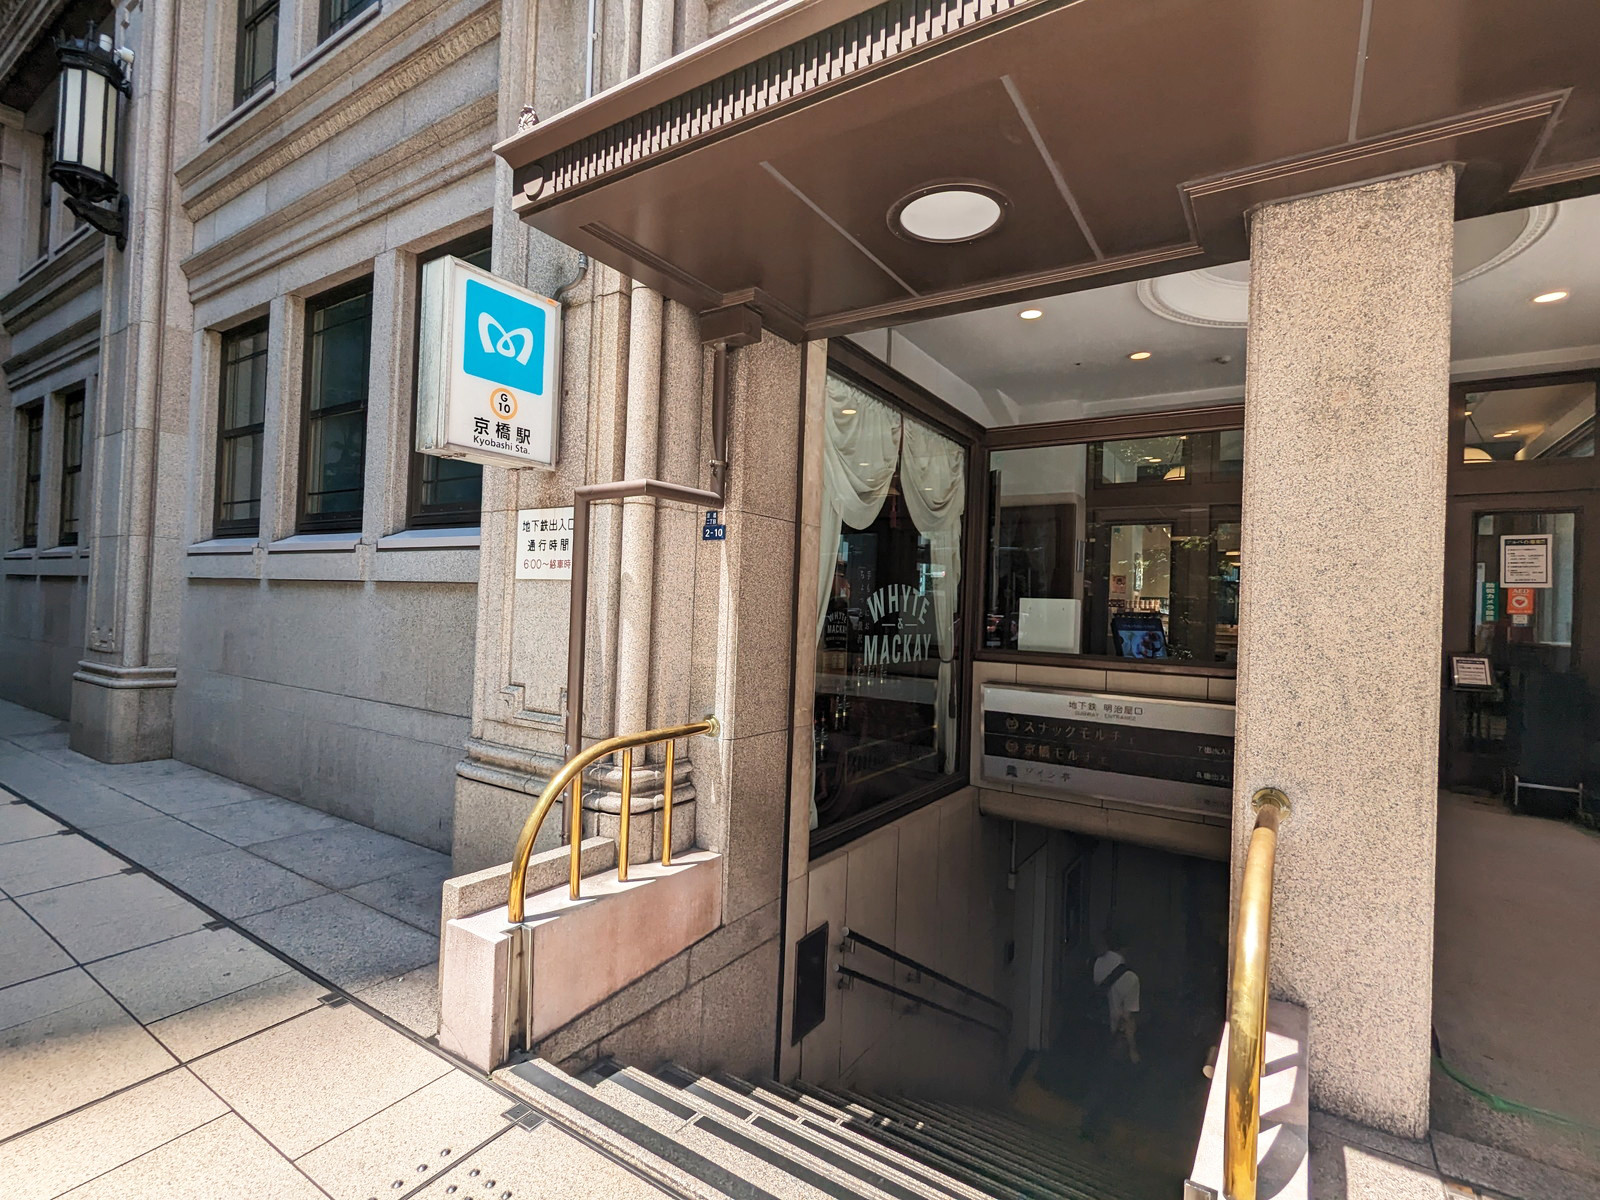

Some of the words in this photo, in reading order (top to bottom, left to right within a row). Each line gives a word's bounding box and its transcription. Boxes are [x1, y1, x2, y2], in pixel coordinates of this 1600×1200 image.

[501, 393, 508, 402] G
[499, 402, 511, 413] 10
[474, 416, 530, 445] 京橋駅
[473, 435, 513, 451] Kyobashi
[515, 444, 531, 454] Sta.
[522, 518, 574, 532] 地下鉄出入口
[705, 528, 723, 538] 2-10
[527, 538, 569, 551] 通行時間
[866, 584, 930, 624] WHYTE
[897, 618, 904, 629] &
[863, 634, 931, 666] MACKAY
[1069, 701, 1097, 711] 地下鉄
[1103, 704, 1143, 715] 明治屋口
